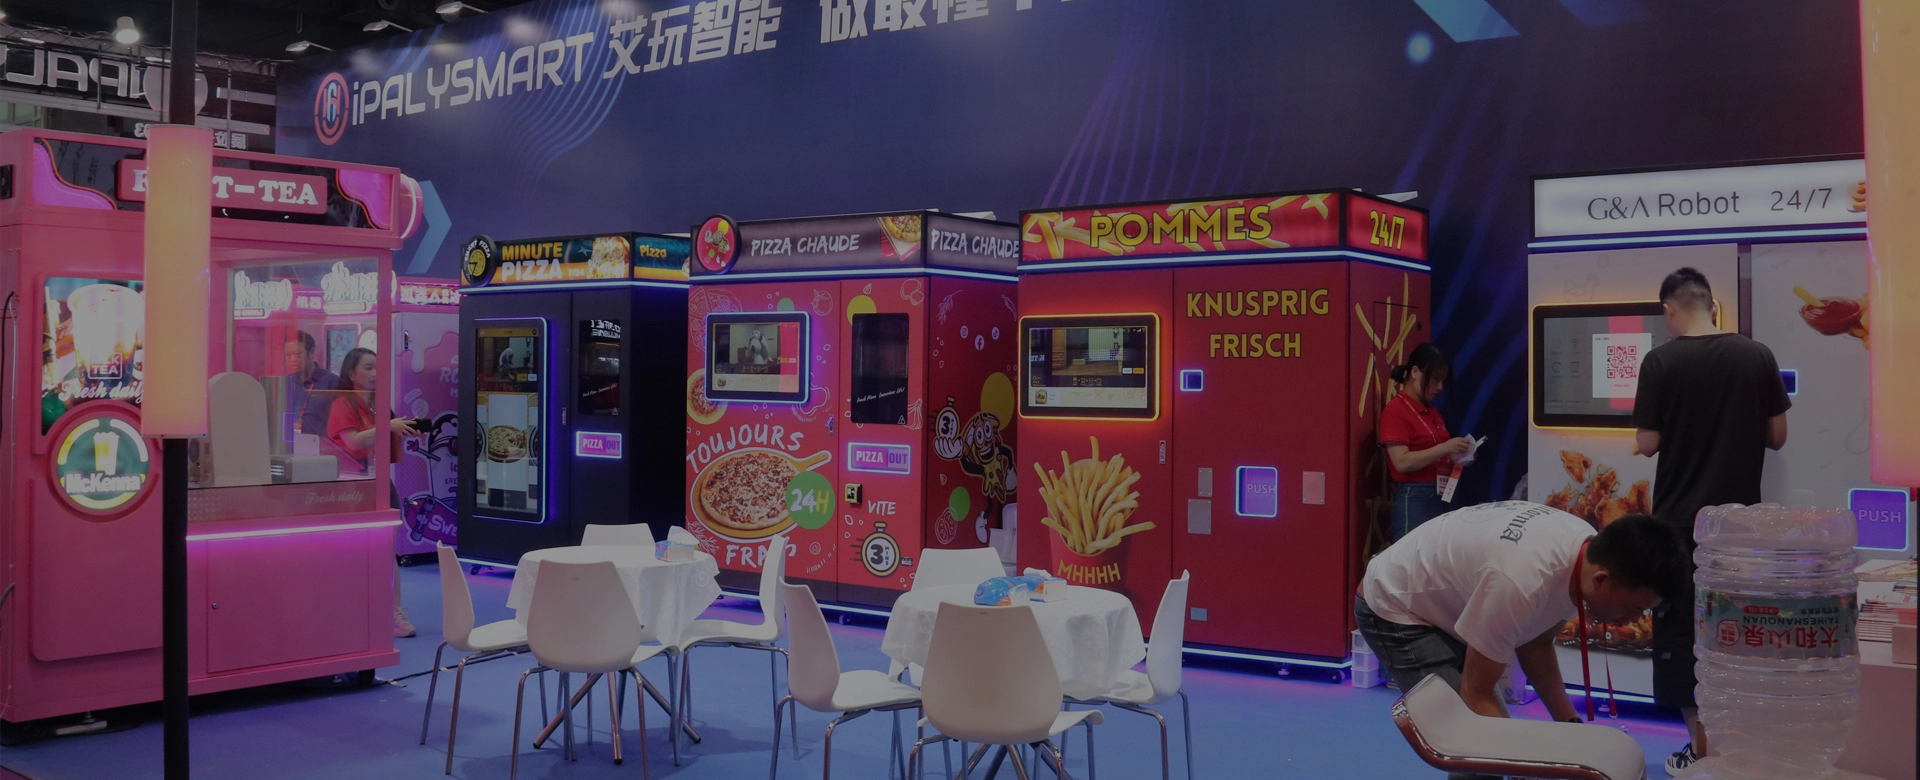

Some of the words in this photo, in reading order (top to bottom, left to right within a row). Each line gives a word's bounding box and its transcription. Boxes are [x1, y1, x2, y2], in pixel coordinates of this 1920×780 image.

[352, 32, 594, 126] iPALYSMART
[603, 0, 783, 80] 艾玩智能
[1658, 190, 1740, 217] Robot
[1770, 188, 1833, 213] 24/7
[1090, 205, 1273, 249] POMMES
[1370, 210, 1405, 251] 24/7
[502, 242, 564, 261] MINUTE
[639, 245, 668, 258] Pizza
[751, 236, 792, 257] PIZZA
[796, 233, 860, 254] CHAUDE
[931, 228, 968, 252] PIZZA
[972, 234, 1019, 259] CHAUDE
[502, 258, 563, 281] PIZZA
[1186, 289, 1329, 318] KNUSPRIG
[1209, 333, 1301, 358] FRISCH
[91, 365, 119, 375] TEA
[59, 381, 107, 402] Fresh
[582, 438, 604, 449] PIZZA
[606, 440, 621, 451] OUT
[686, 423, 804, 474] TOUJOURS
[856, 450, 884, 464] PIZZA
[889, 452, 909, 465] OUT
[65, 472, 141, 494] McKenna
[1246, 483, 1277, 495] PUSH
[305, 491, 336, 506] Fresh
[337, 490, 365, 505] daily
[790, 488, 830, 515] 24H
[867, 500, 896, 516] VITE
[1858, 509, 1902, 523] PUSH
[870, 544, 884, 565] 3
[1057, 559, 1121, 585] MHHHH
[1742, 615, 1840, 626] TAIHESHANQUAN
[1742, 624, 1840, 649] 太和山泉
